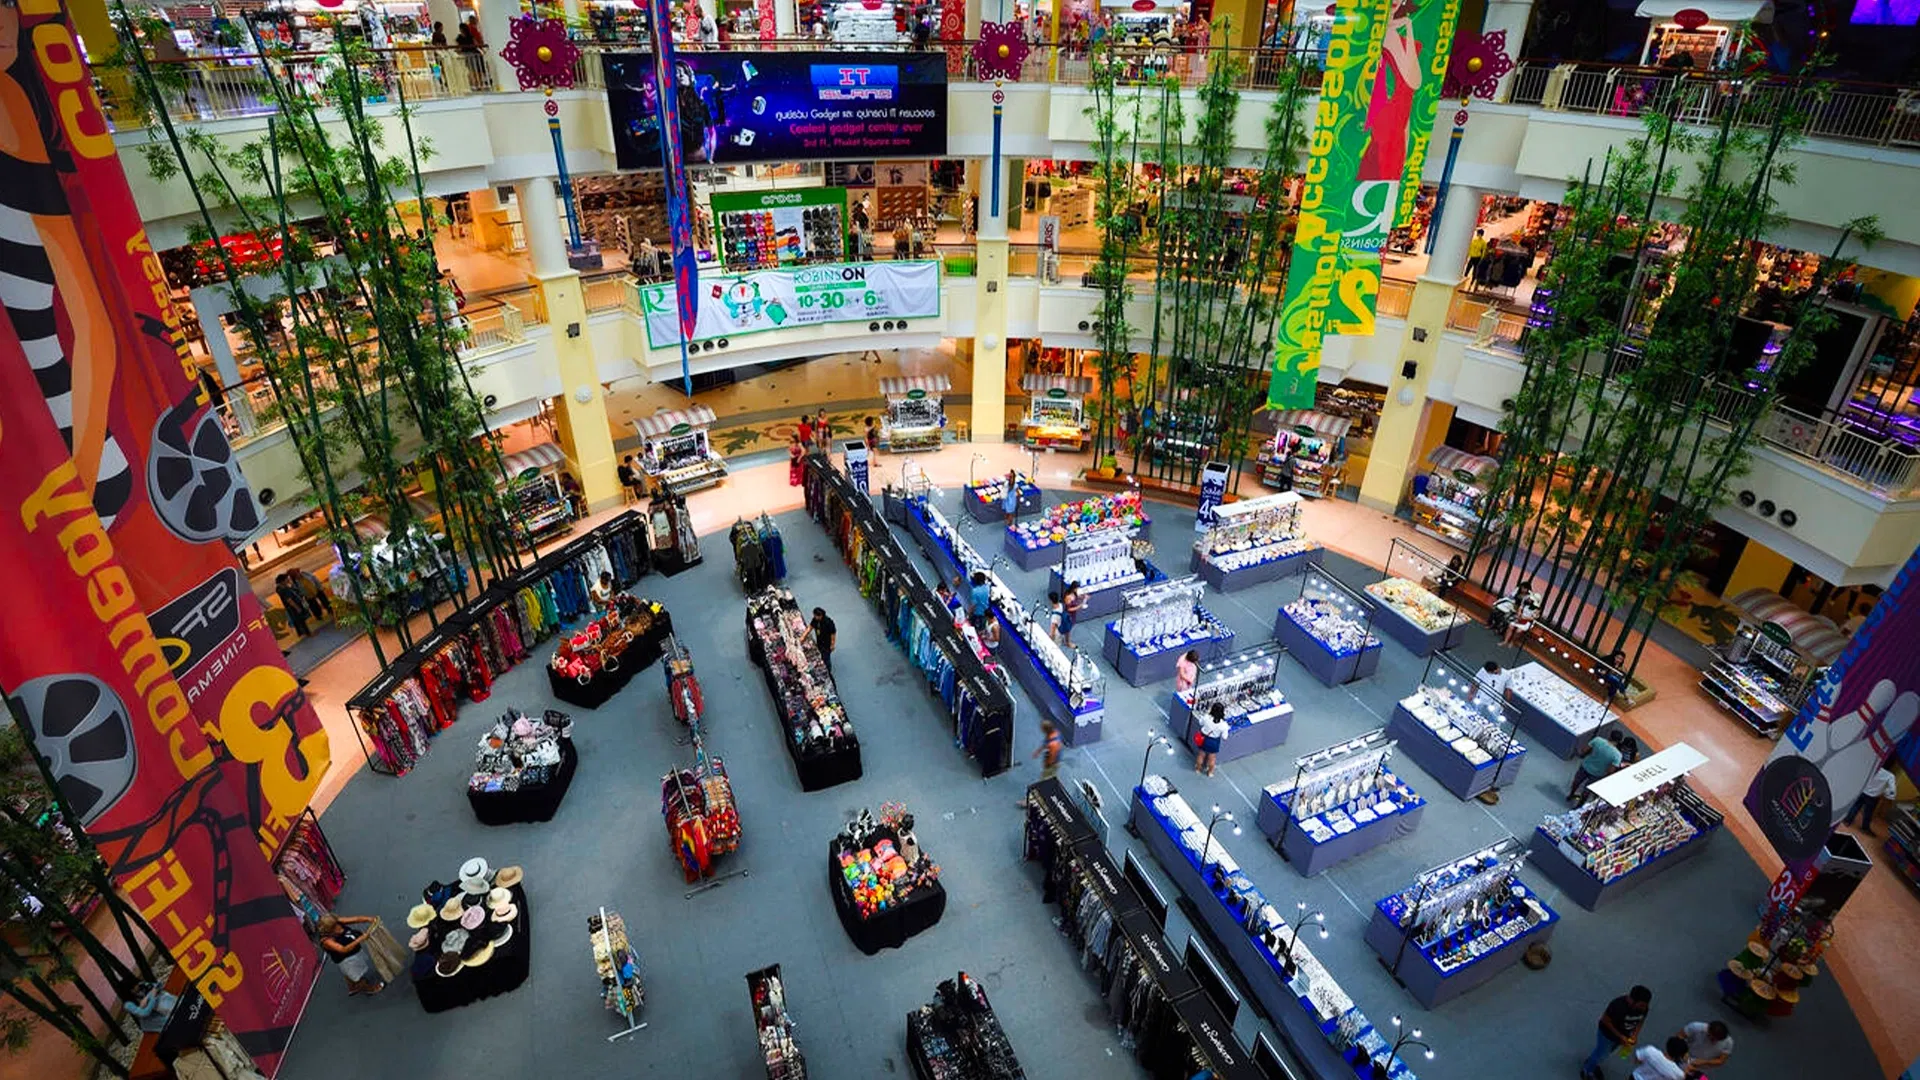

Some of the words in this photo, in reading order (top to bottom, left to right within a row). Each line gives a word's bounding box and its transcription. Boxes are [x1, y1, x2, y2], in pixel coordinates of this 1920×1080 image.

[839, 68, 870, 85] IT
[761, 193, 803, 205] crocs
[793, 267, 866, 283] ROBINSON
[1633, 763, 1669, 783] SHELL
